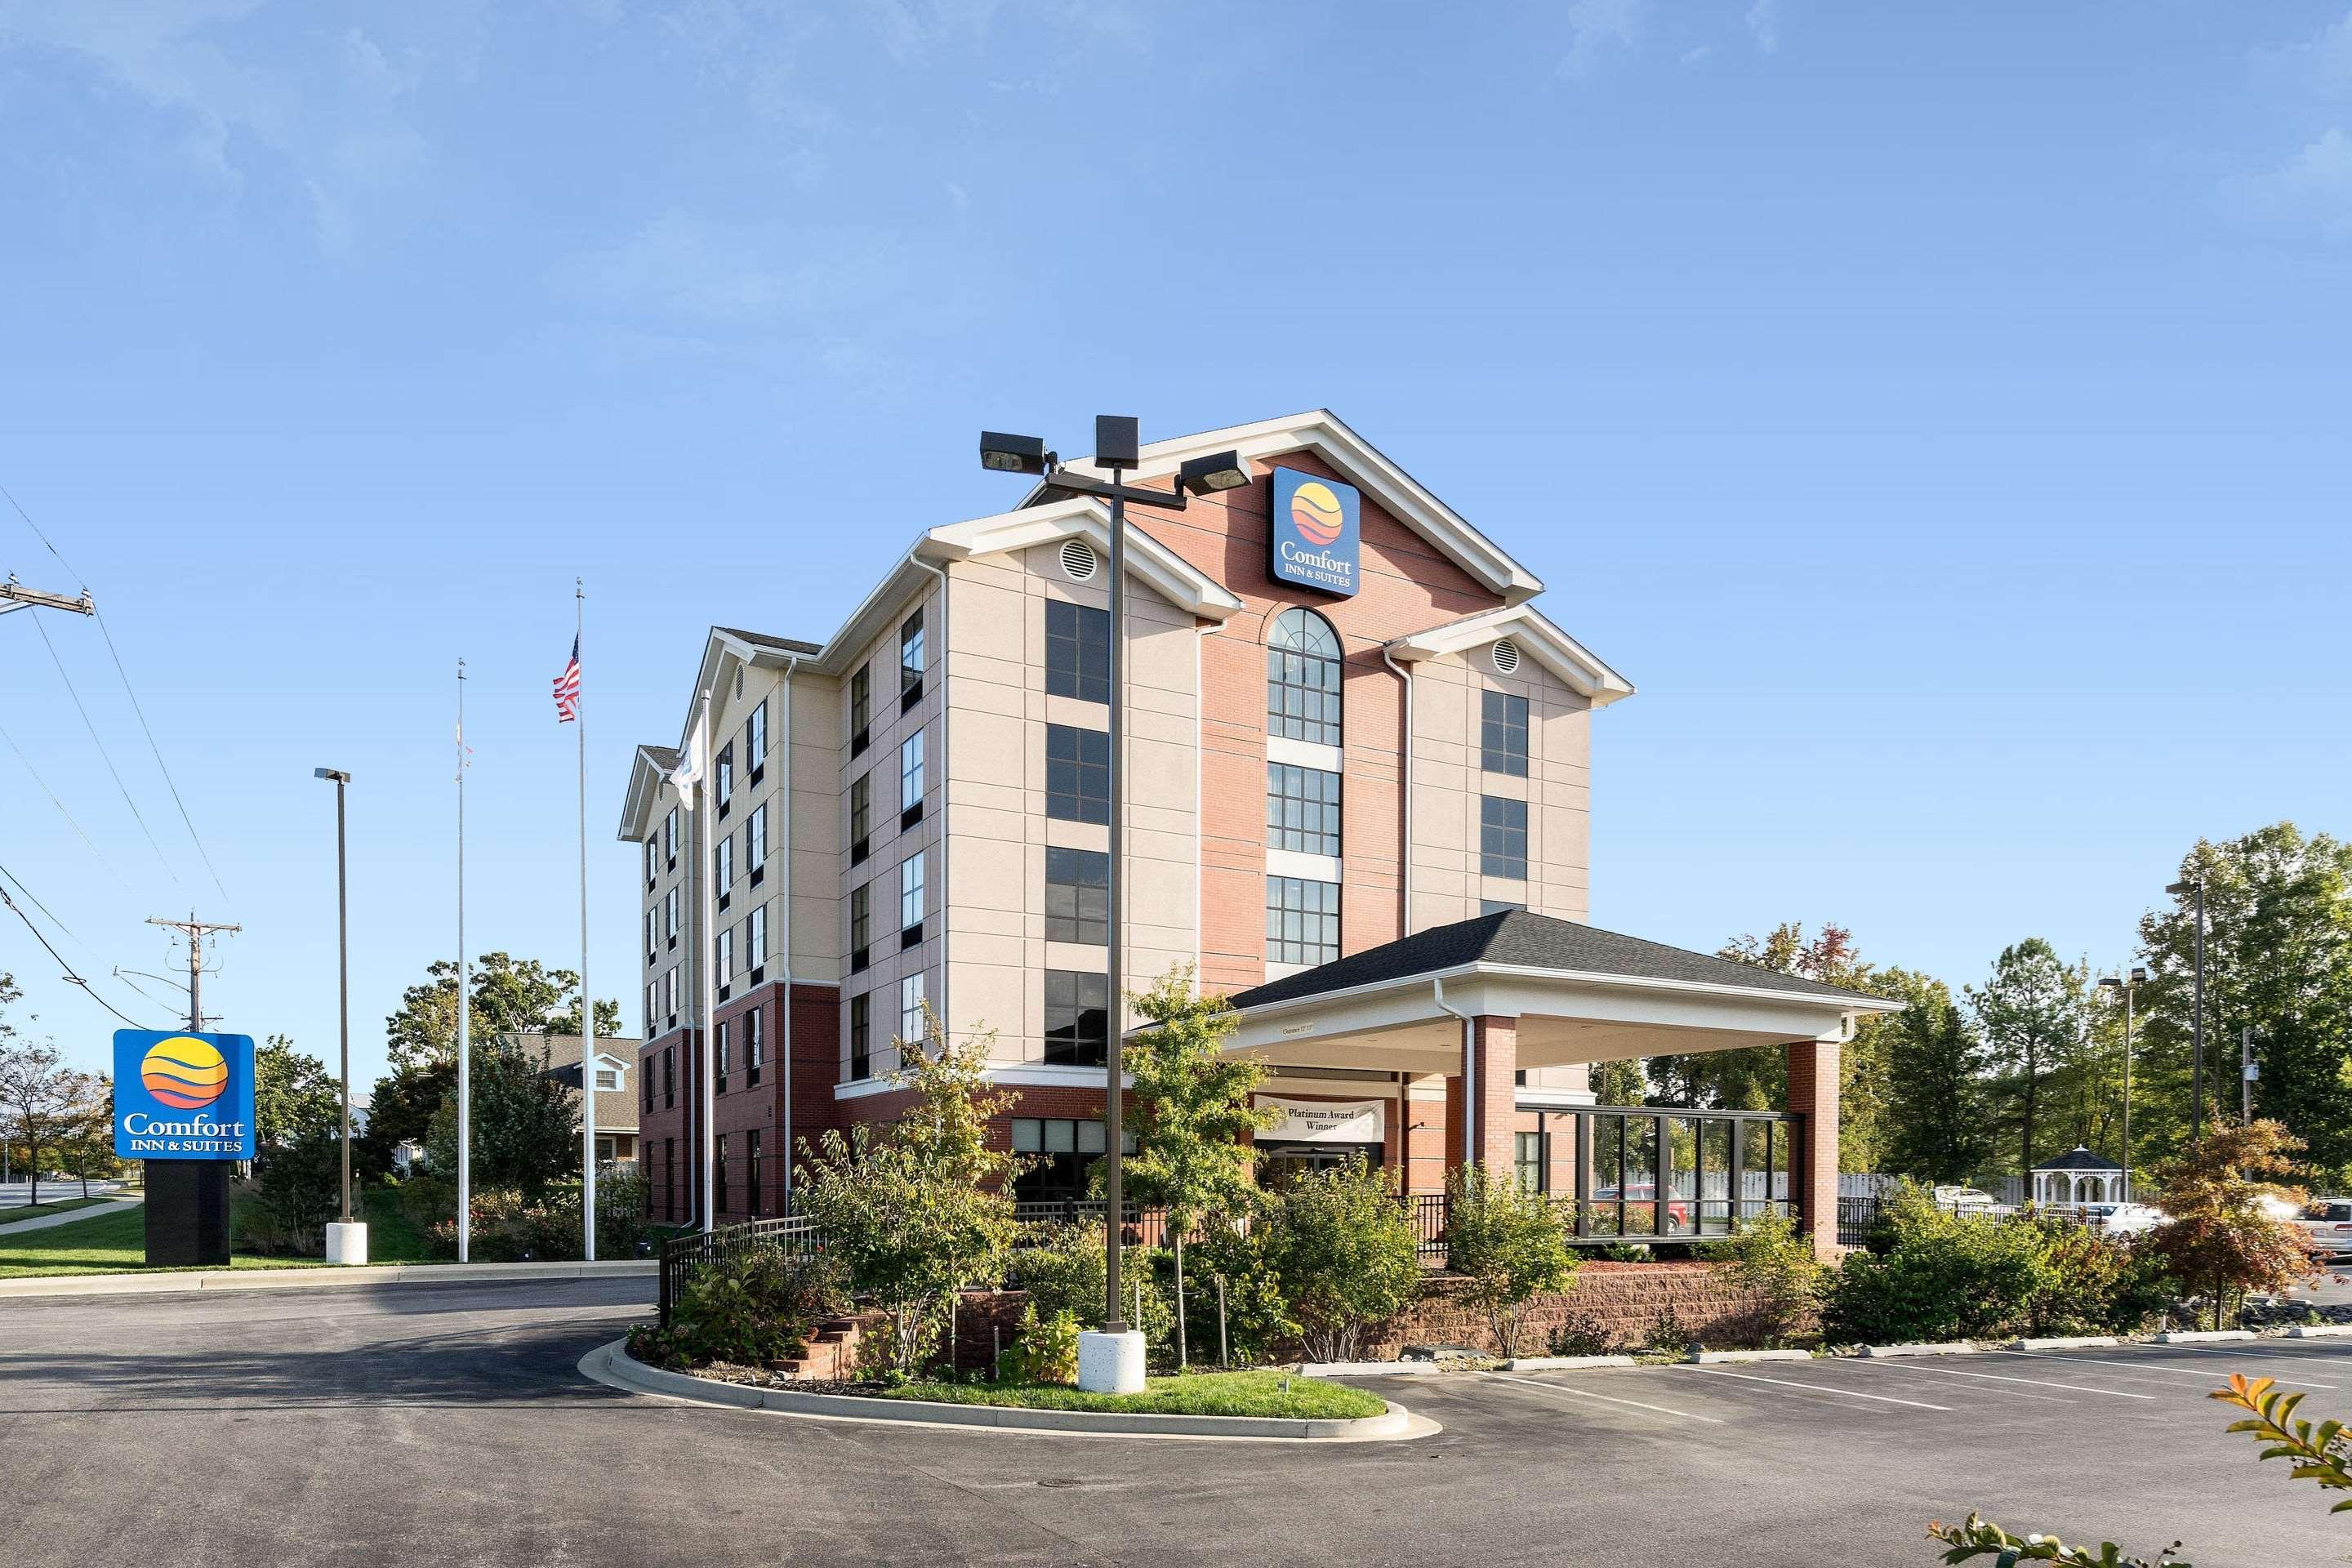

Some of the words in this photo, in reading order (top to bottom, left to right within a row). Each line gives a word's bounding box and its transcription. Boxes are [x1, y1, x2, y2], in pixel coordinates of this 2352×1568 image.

[1281, 541, 1352, 575] Comfort
[1285, 563, 1305, 577] INN
[1307, 569, 1314, 578] &
[1315, 571, 1350, 587] SUITES
[1288, 1108, 1326, 1119] Platinum
[1328, 1110, 1354, 1119] Award
[123, 1112, 245, 1137] Comfort
[1306, 1121, 1338, 1130] Winner
[130, 1139, 165, 1151] INN
[168, 1140, 180, 1151] &
[182, 1140, 243, 1152] SUITES
